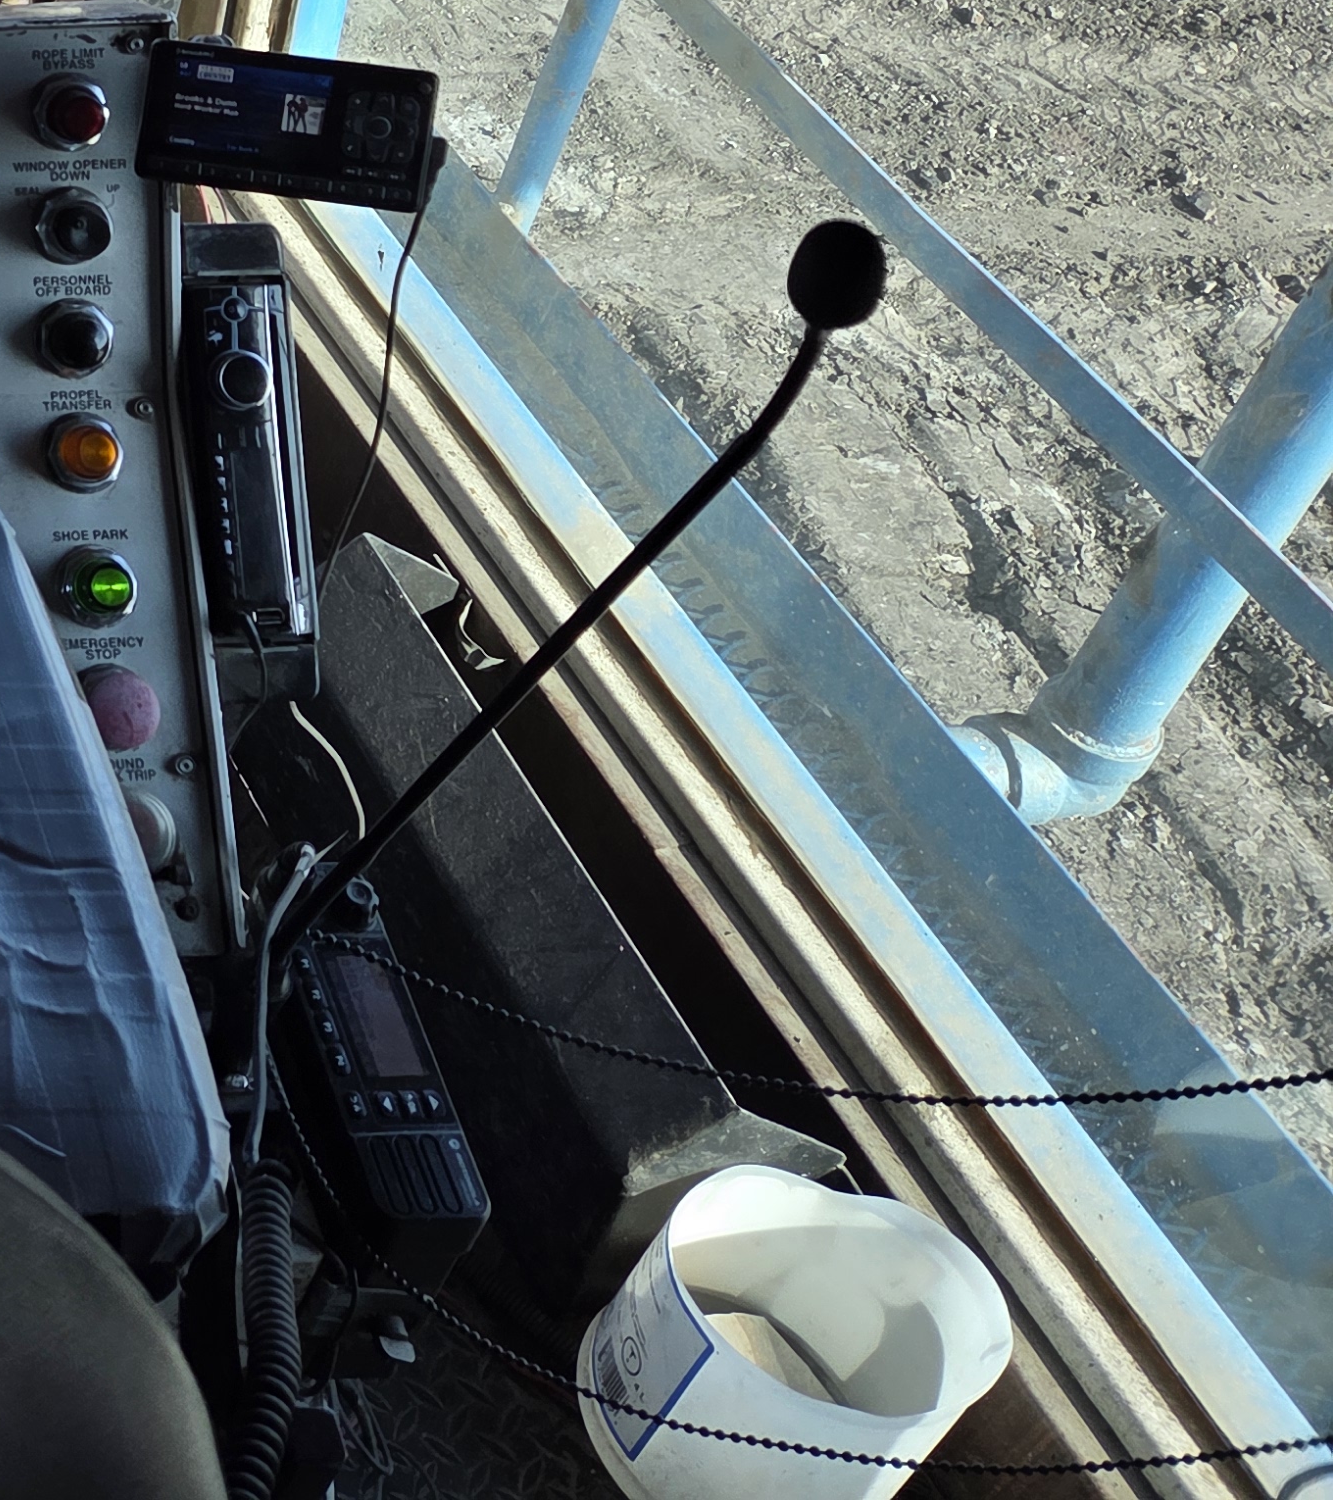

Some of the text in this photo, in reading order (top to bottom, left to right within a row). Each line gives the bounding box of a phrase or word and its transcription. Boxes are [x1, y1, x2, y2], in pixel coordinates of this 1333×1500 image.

[31, 47, 105, 62] ROPE LIMIT
[43, 58, 95, 71] BYPASS
[12, 158, 127, 174] WINDOW OPENER
[50, 170, 90, 182] DOWN
[106, 184, 120, 194] UP
[33, 275, 113, 287] PERSONNEL
[35, 284, 111, 298] OFF BOARD
[50, 390, 103, 401] PROPEL
[42, 400, 112, 412] TRANSFER
[53, 528, 129, 542] SHOE PARK
[62, 636, 144, 651] EMERGENCY
[85, 649, 121, 661] STOP
[126, 768, 156, 781] TRIP
